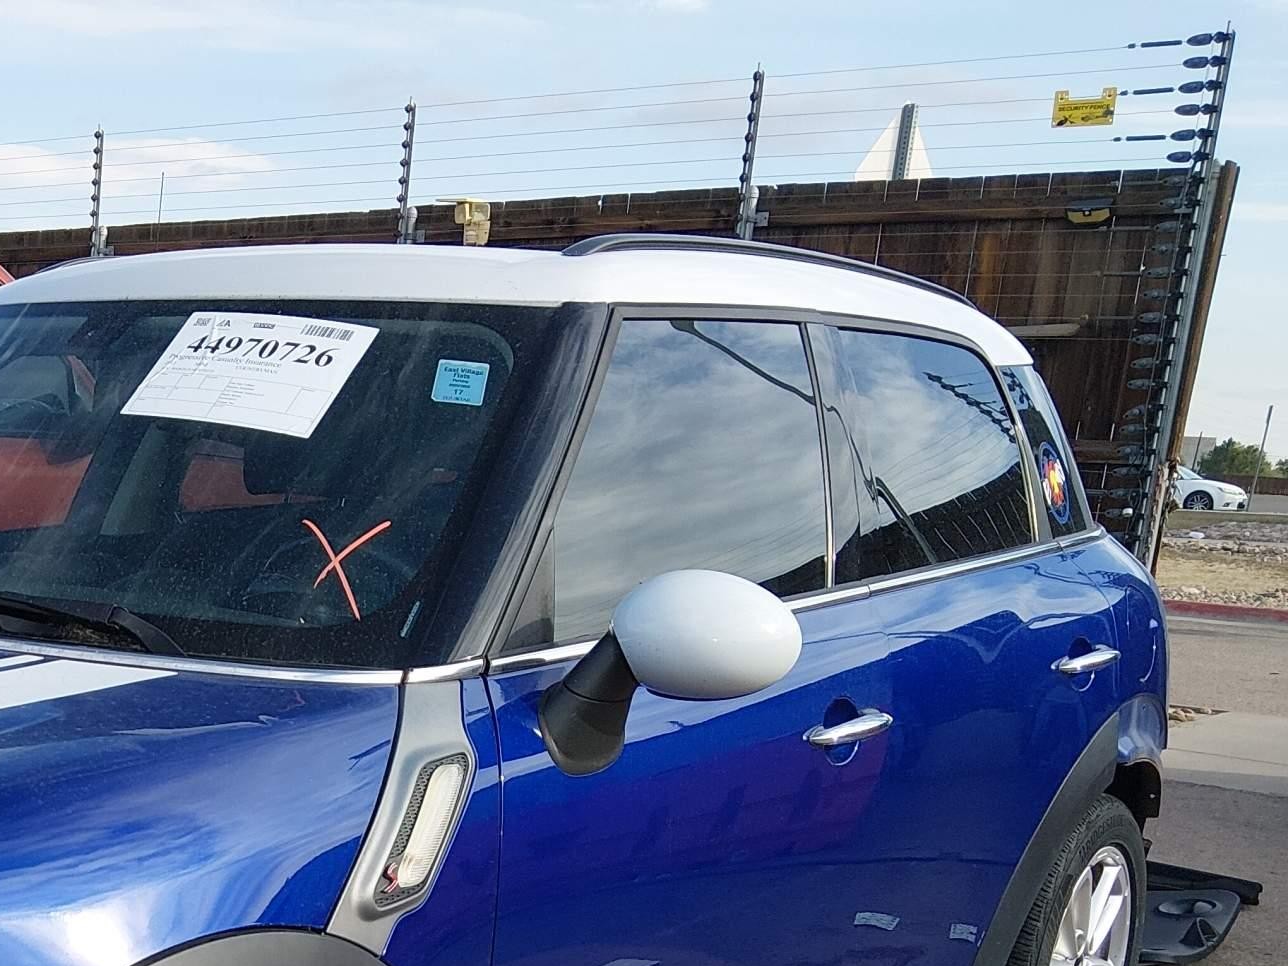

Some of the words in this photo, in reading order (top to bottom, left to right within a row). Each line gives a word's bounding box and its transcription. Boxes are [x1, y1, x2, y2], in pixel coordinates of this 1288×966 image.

[187, 334, 342, 367] 44970726
[245, 357, 282, 368] Insurance
[461, 367, 484, 376] Village
